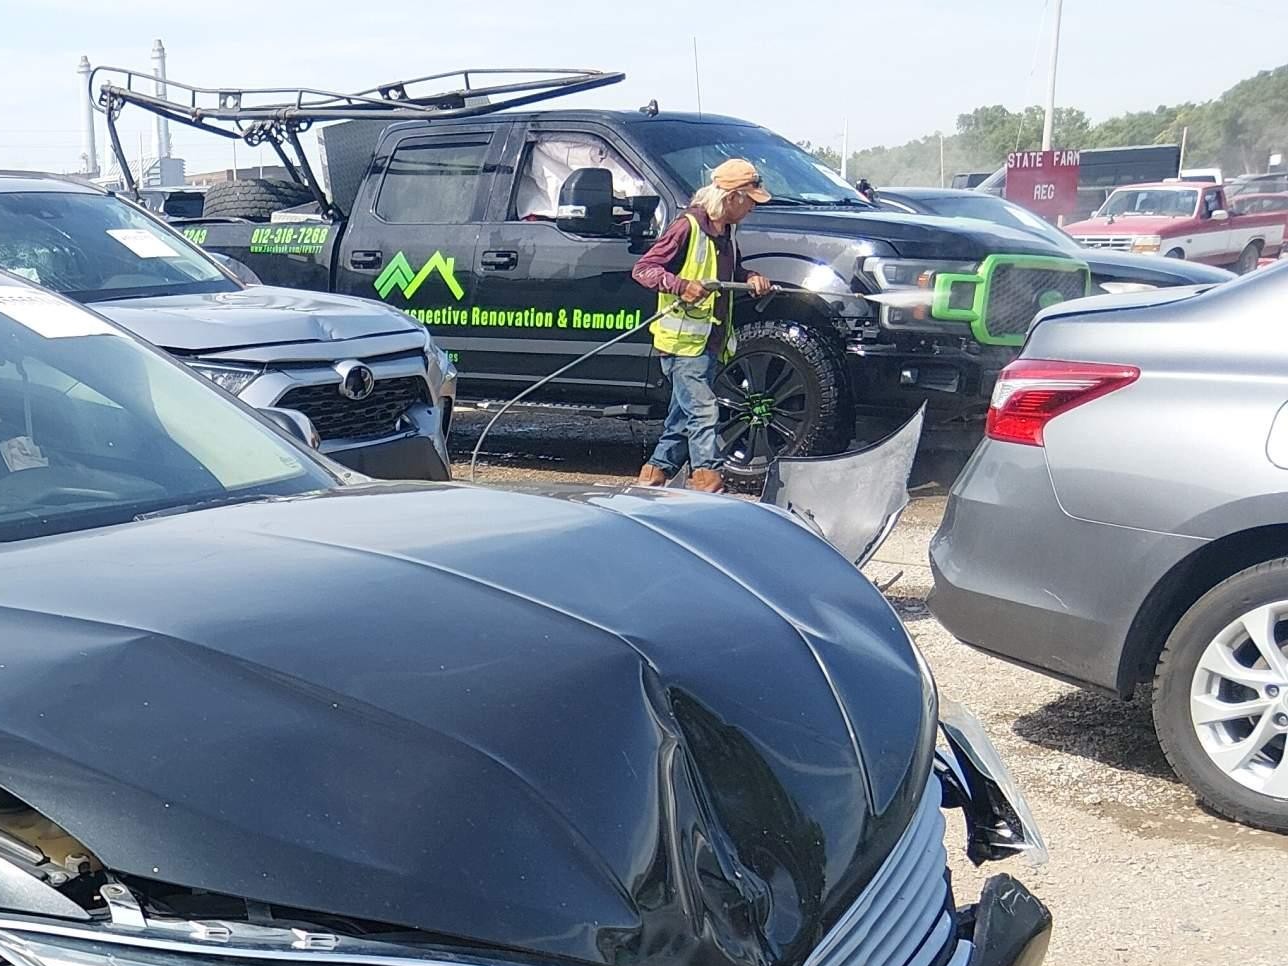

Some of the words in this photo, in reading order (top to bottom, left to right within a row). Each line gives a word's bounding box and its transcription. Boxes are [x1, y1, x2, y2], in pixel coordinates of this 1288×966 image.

[1007, 151, 1044, 168] STATE
[1053, 151, 1080, 166] FARM
[1033, 184, 1055, 200] REG
[471, 306, 553, 327] Renovation
[557, 309, 568, 328] &
[572, 309, 641, 329] Remodel
